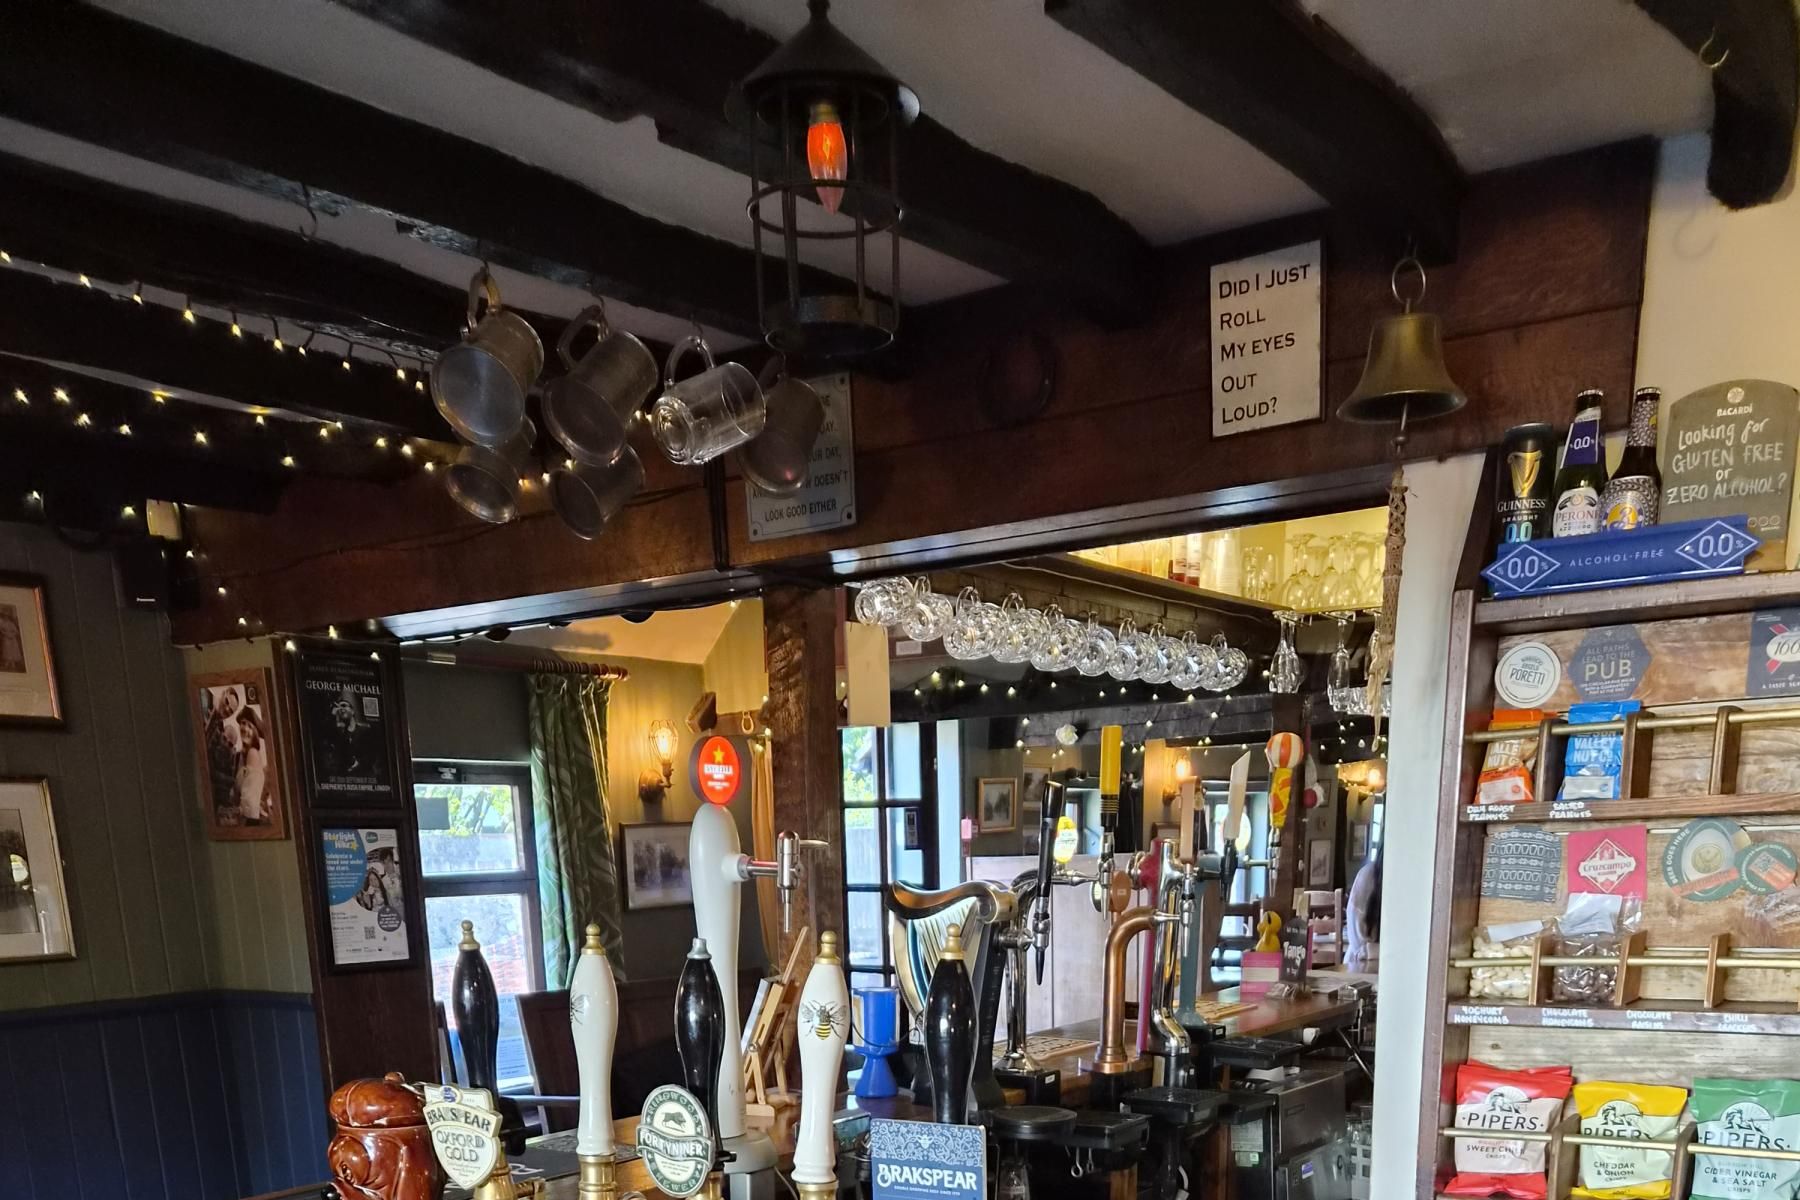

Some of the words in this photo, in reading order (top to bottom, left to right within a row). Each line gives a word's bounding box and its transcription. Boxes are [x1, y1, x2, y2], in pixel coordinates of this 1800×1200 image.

[1219, 278, 1250, 299] DID
[1255, 273, 1260, 291] I
[1265, 264, 1311, 289] JUST
[1219, 308, 1266, 330] ROLL
[1220, 343, 1246, 362] MY
[1252, 332, 1295, 355] EYES
[1221, 373, 1257, 393] OUT
[1222, 396, 1278, 425] LOUD?
[1678, 423, 1736, 451] Looking
[1741, 417, 1770, 444] for
[1672, 447, 1734, 475] GLUTEN
[1743, 442, 1783, 465] FREE
[815, 470, 848, 488] DOESN'T
[1715, 467, 1733, 481] or
[1666, 484, 1709, 505] ZERO
[765, 508, 784, 522] LOOK
[786, 504, 807, 519] GOOD
[809, 498, 837, 515] EITHER
[1497, 498, 1547, 513] GUINNESS
[1502, 514, 1538, 523] DRAUGHT
[1506, 521, 1533, 543] 0.0
[1582, 655, 1604, 664] LEAD
[1605, 653, 1617, 661] TO
[1619, 650, 1635, 659] THE
[1509, 667, 1546, 686] PORETTI
[1585, 659, 1632, 682] PUB
[306, 680, 341, 692] GEORGE
[343, 683, 381, 695] MICHAEL
[1491, 742, 1521, 756] ALLE
[1574, 736, 1617, 750] VALLEY
[1573, 750, 1597, 763] NUT
[1549, 810, 1592, 819] PEANUTS
[1665, 845, 1676, 865] GOES
[1672, 828, 1691, 846] HERE
[1583, 860, 1633, 873] Cruzcampo
[1283, 941, 1306, 968] Tango
[427, 1106, 491, 1131] BRASEAR
[1467, 1112, 1540, 1130] PIPERS
[436, 1130, 485, 1149] OXFORD
[640, 1129, 704, 1157] FORTYNINER
[1466, 1144, 1496, 1153] SWEET
[1704, 1131, 1785, 1151] PIPERS
[444, 1145, 479, 1162] GOLD
[1594, 1161, 1635, 1170] CHEDDAR
[1735, 1169, 1777, 1180] VINEGAR
[877, 1163, 977, 1191] BRAKSPEAR
